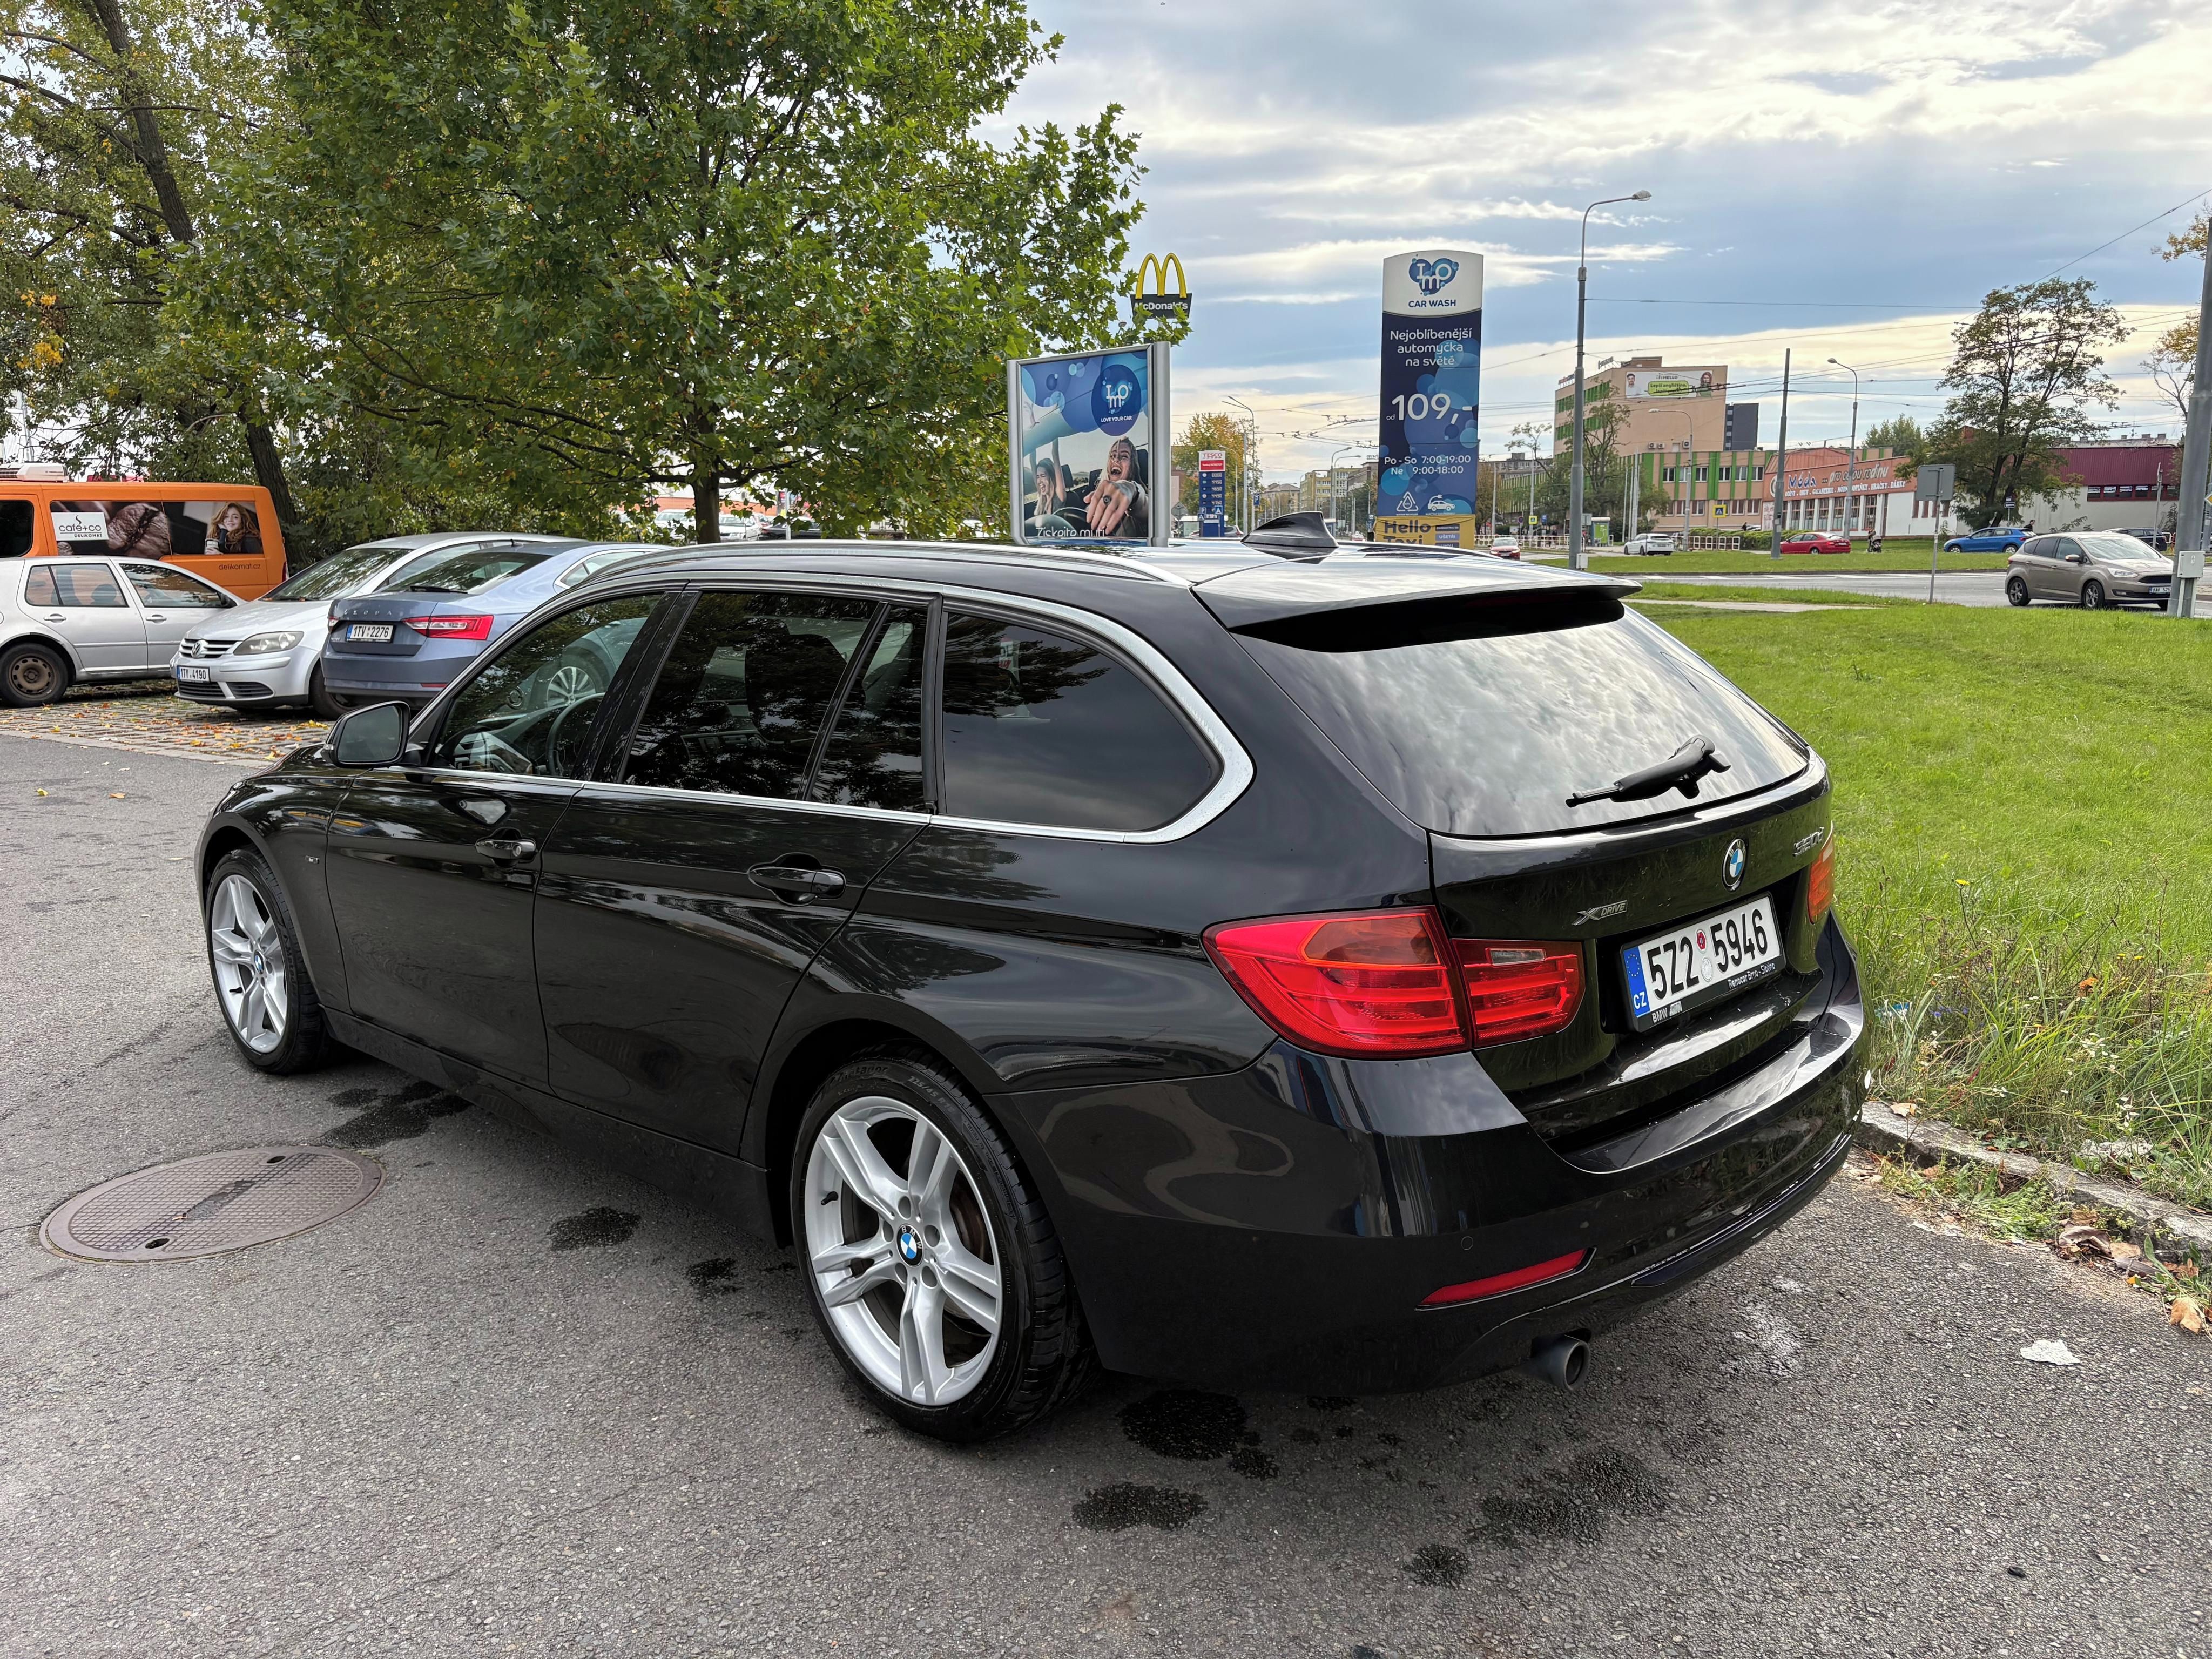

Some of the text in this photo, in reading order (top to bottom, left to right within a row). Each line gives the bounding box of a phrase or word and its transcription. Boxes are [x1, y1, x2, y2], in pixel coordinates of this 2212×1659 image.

[1390, 328, 1473, 342] Nejoblíbenější
[1397, 342, 1463, 354] automyčka
[1423, 355, 1454, 366] světě
[1421, 455, 1471, 463] 7:00-19:00
[1412, 466, 1464, 474] 9:00-18:00
[1843, 468, 1863, 482] ceou
[1384, 520, 1431, 534] Hello
[354, 626, 389, 638] 1TV 2276
[192, 670, 206, 679] 4190
[1647, 909, 1768, 1000] 5Z2 5946
[1728, 974, 1748, 989] Renocar
[1746, 970, 1759, 980] Brno
[1633, 992, 1647, 1009] CZ
[1652, 1007, 1668, 1023] BMW
